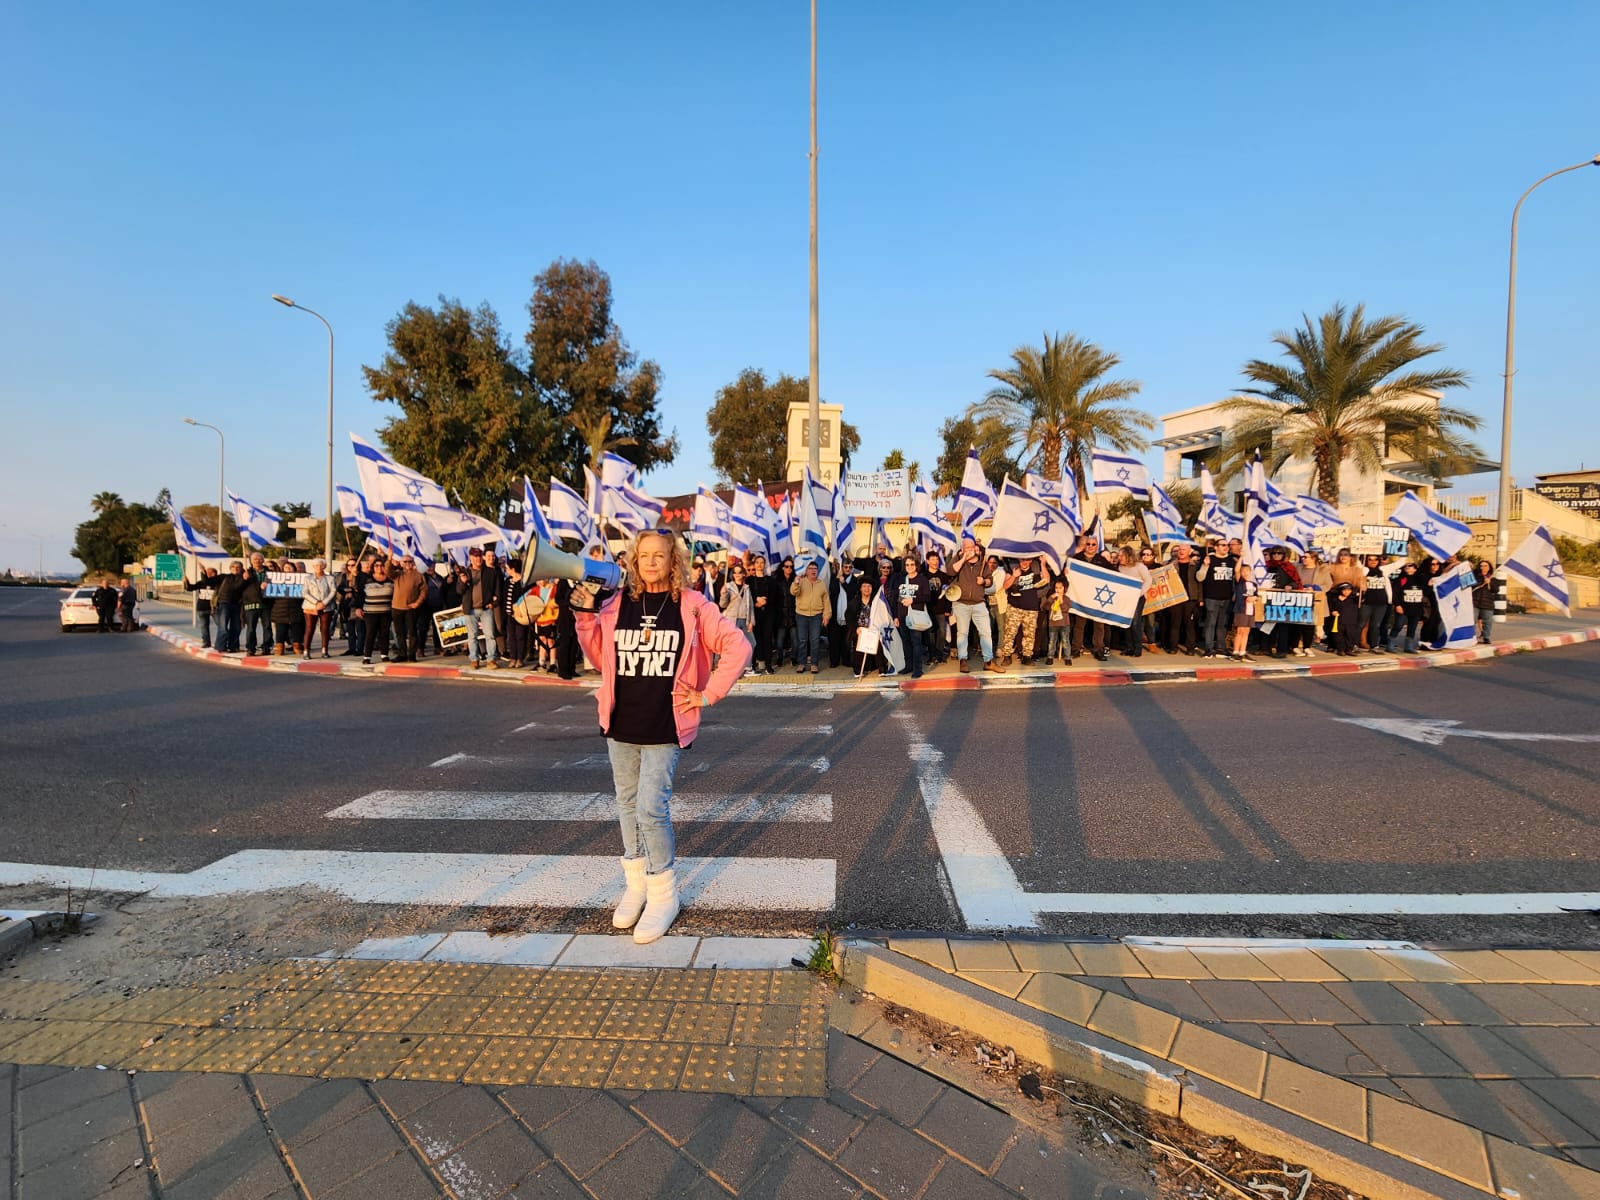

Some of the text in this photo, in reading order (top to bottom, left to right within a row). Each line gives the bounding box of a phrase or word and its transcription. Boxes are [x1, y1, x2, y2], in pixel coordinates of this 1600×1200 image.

[265, 584, 304, 597] ארצנו
[1263, 592, 1313, 606] חופשי
[1265, 605, 1313, 622] בארצנו
[617, 651, 676, 677] בארצנ
